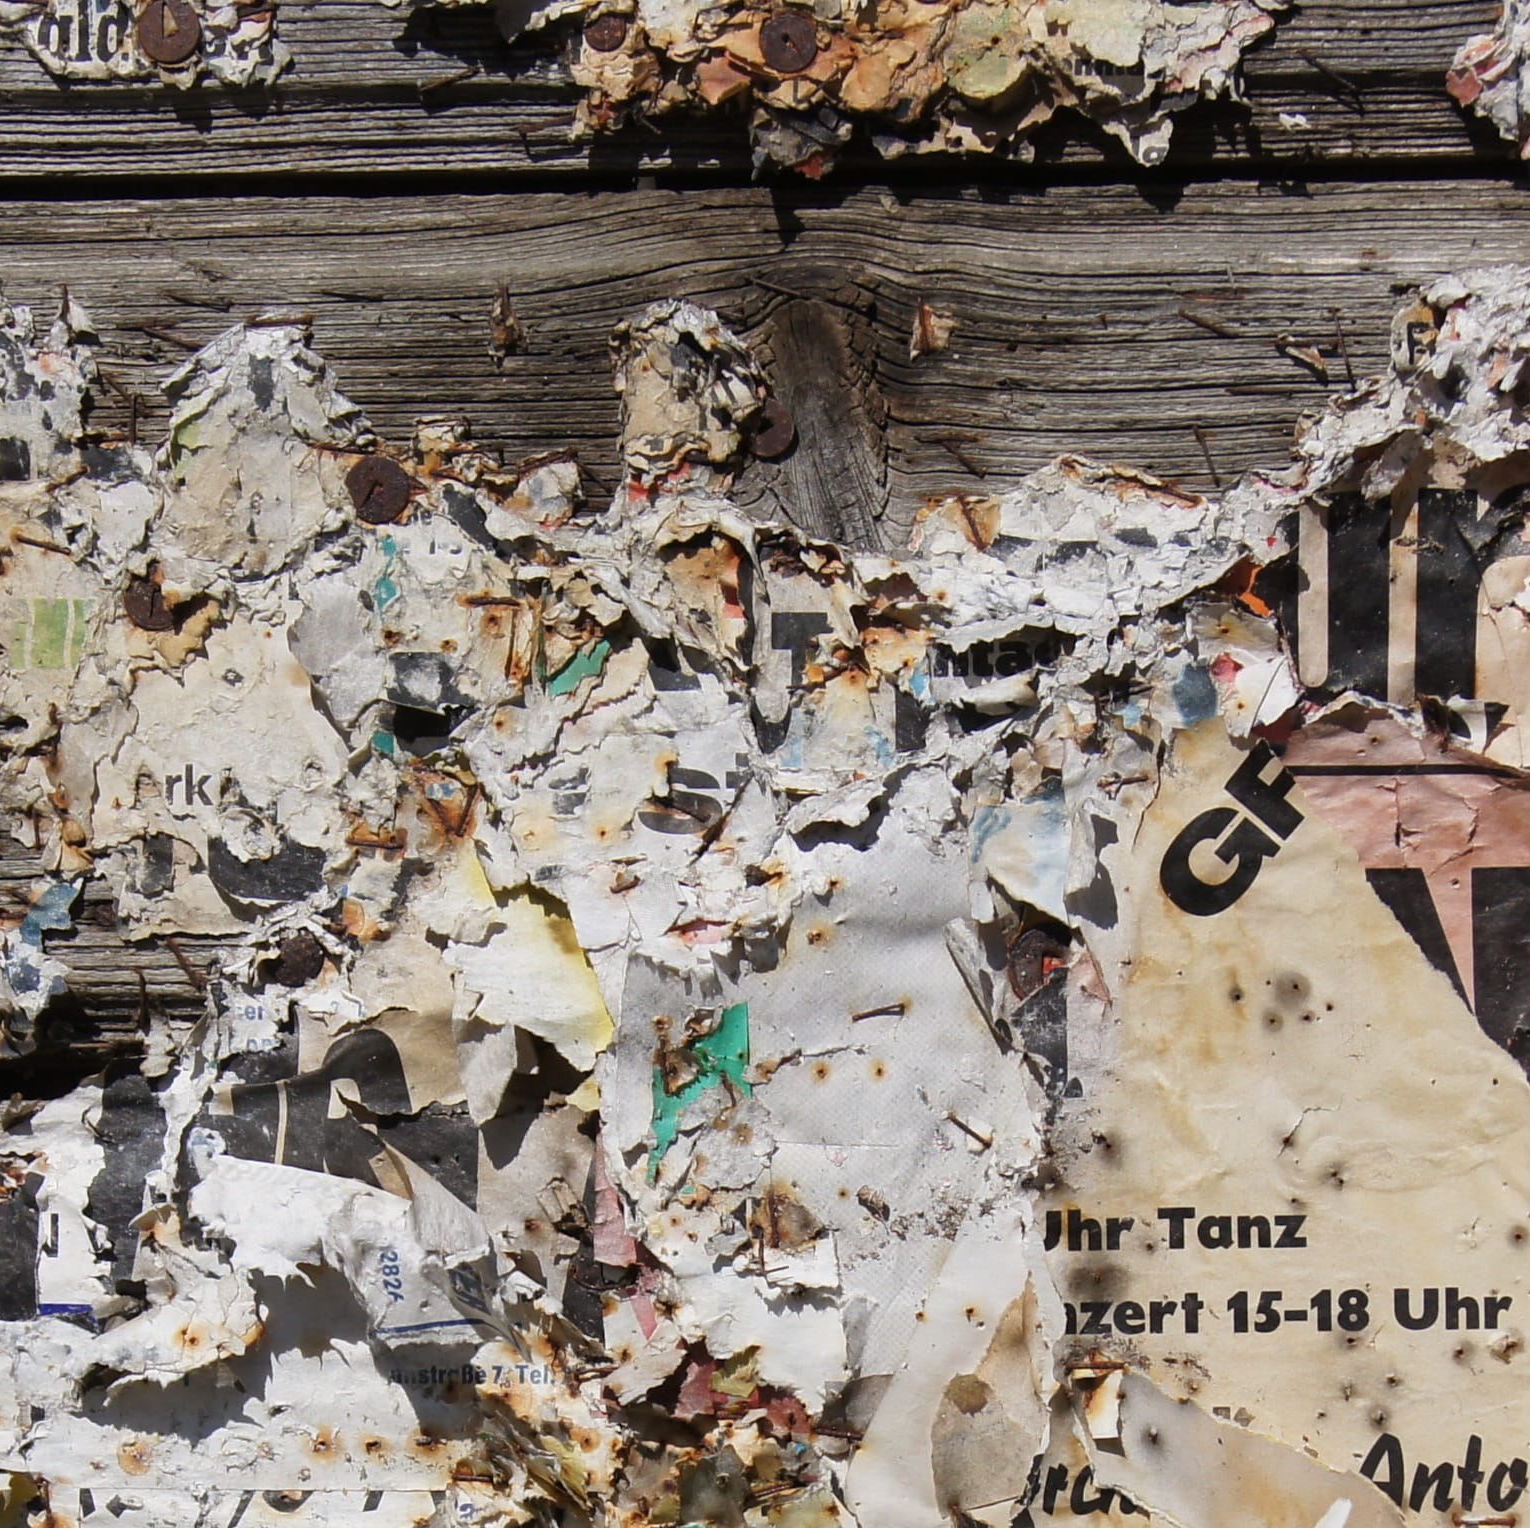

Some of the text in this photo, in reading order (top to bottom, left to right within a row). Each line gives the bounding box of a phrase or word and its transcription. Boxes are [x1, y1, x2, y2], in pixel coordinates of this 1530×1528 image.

[1156, 1206, 1308, 1250] Tanz
[1227, 1287, 1370, 1334] 15-18
[1394, 1286, 1513, 1331] Uhr
